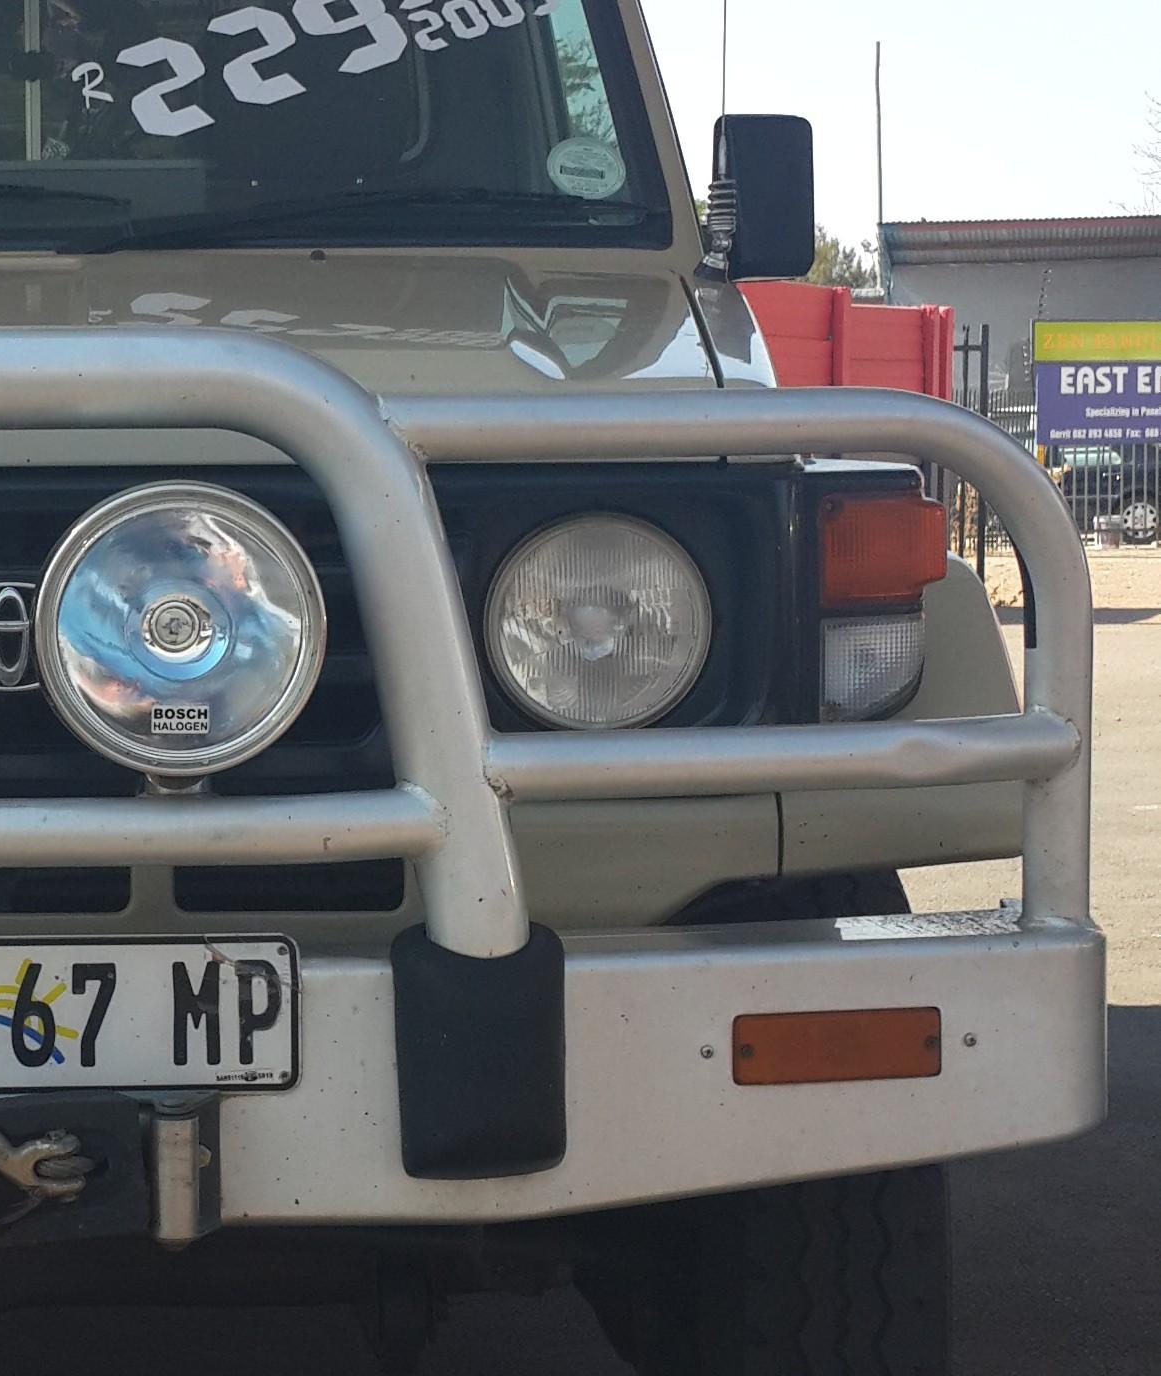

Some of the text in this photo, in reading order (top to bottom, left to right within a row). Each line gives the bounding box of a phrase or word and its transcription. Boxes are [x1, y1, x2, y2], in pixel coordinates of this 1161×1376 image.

[71, 61, 114, 109] R
[1060, 366, 1129, 394] EAST
[153, 708, 208, 720] BOSCH
[153, 721, 208, 731] HALOGEN
[171, 959, 282, 1066] MP
